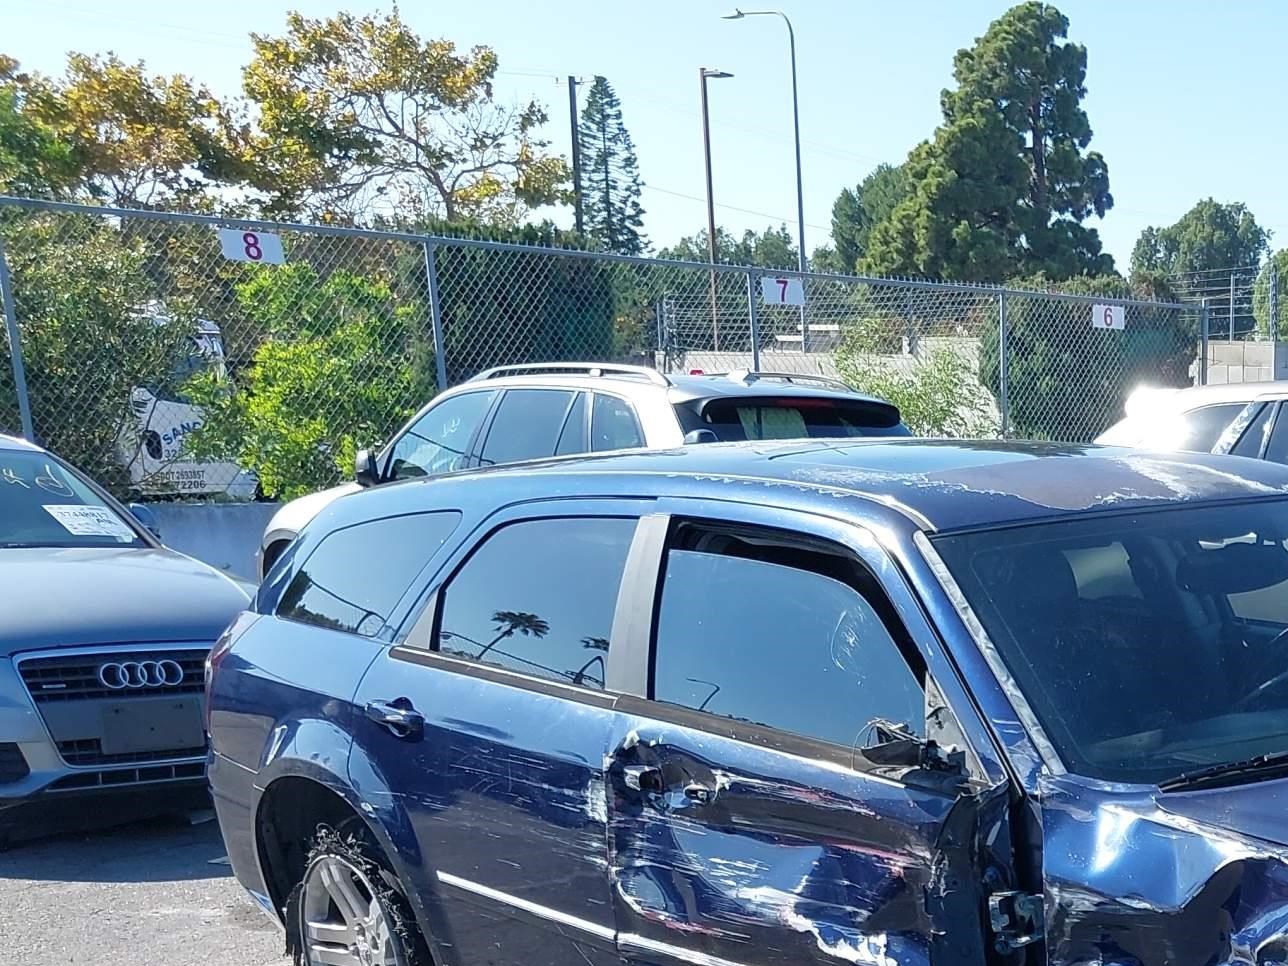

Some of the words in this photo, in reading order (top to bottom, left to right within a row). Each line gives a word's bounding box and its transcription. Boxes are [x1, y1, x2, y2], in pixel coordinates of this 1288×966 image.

[243, 232, 263, 260] 8
[776, 280, 788, 302] 7
[1103, 307, 1113, 327] 6
